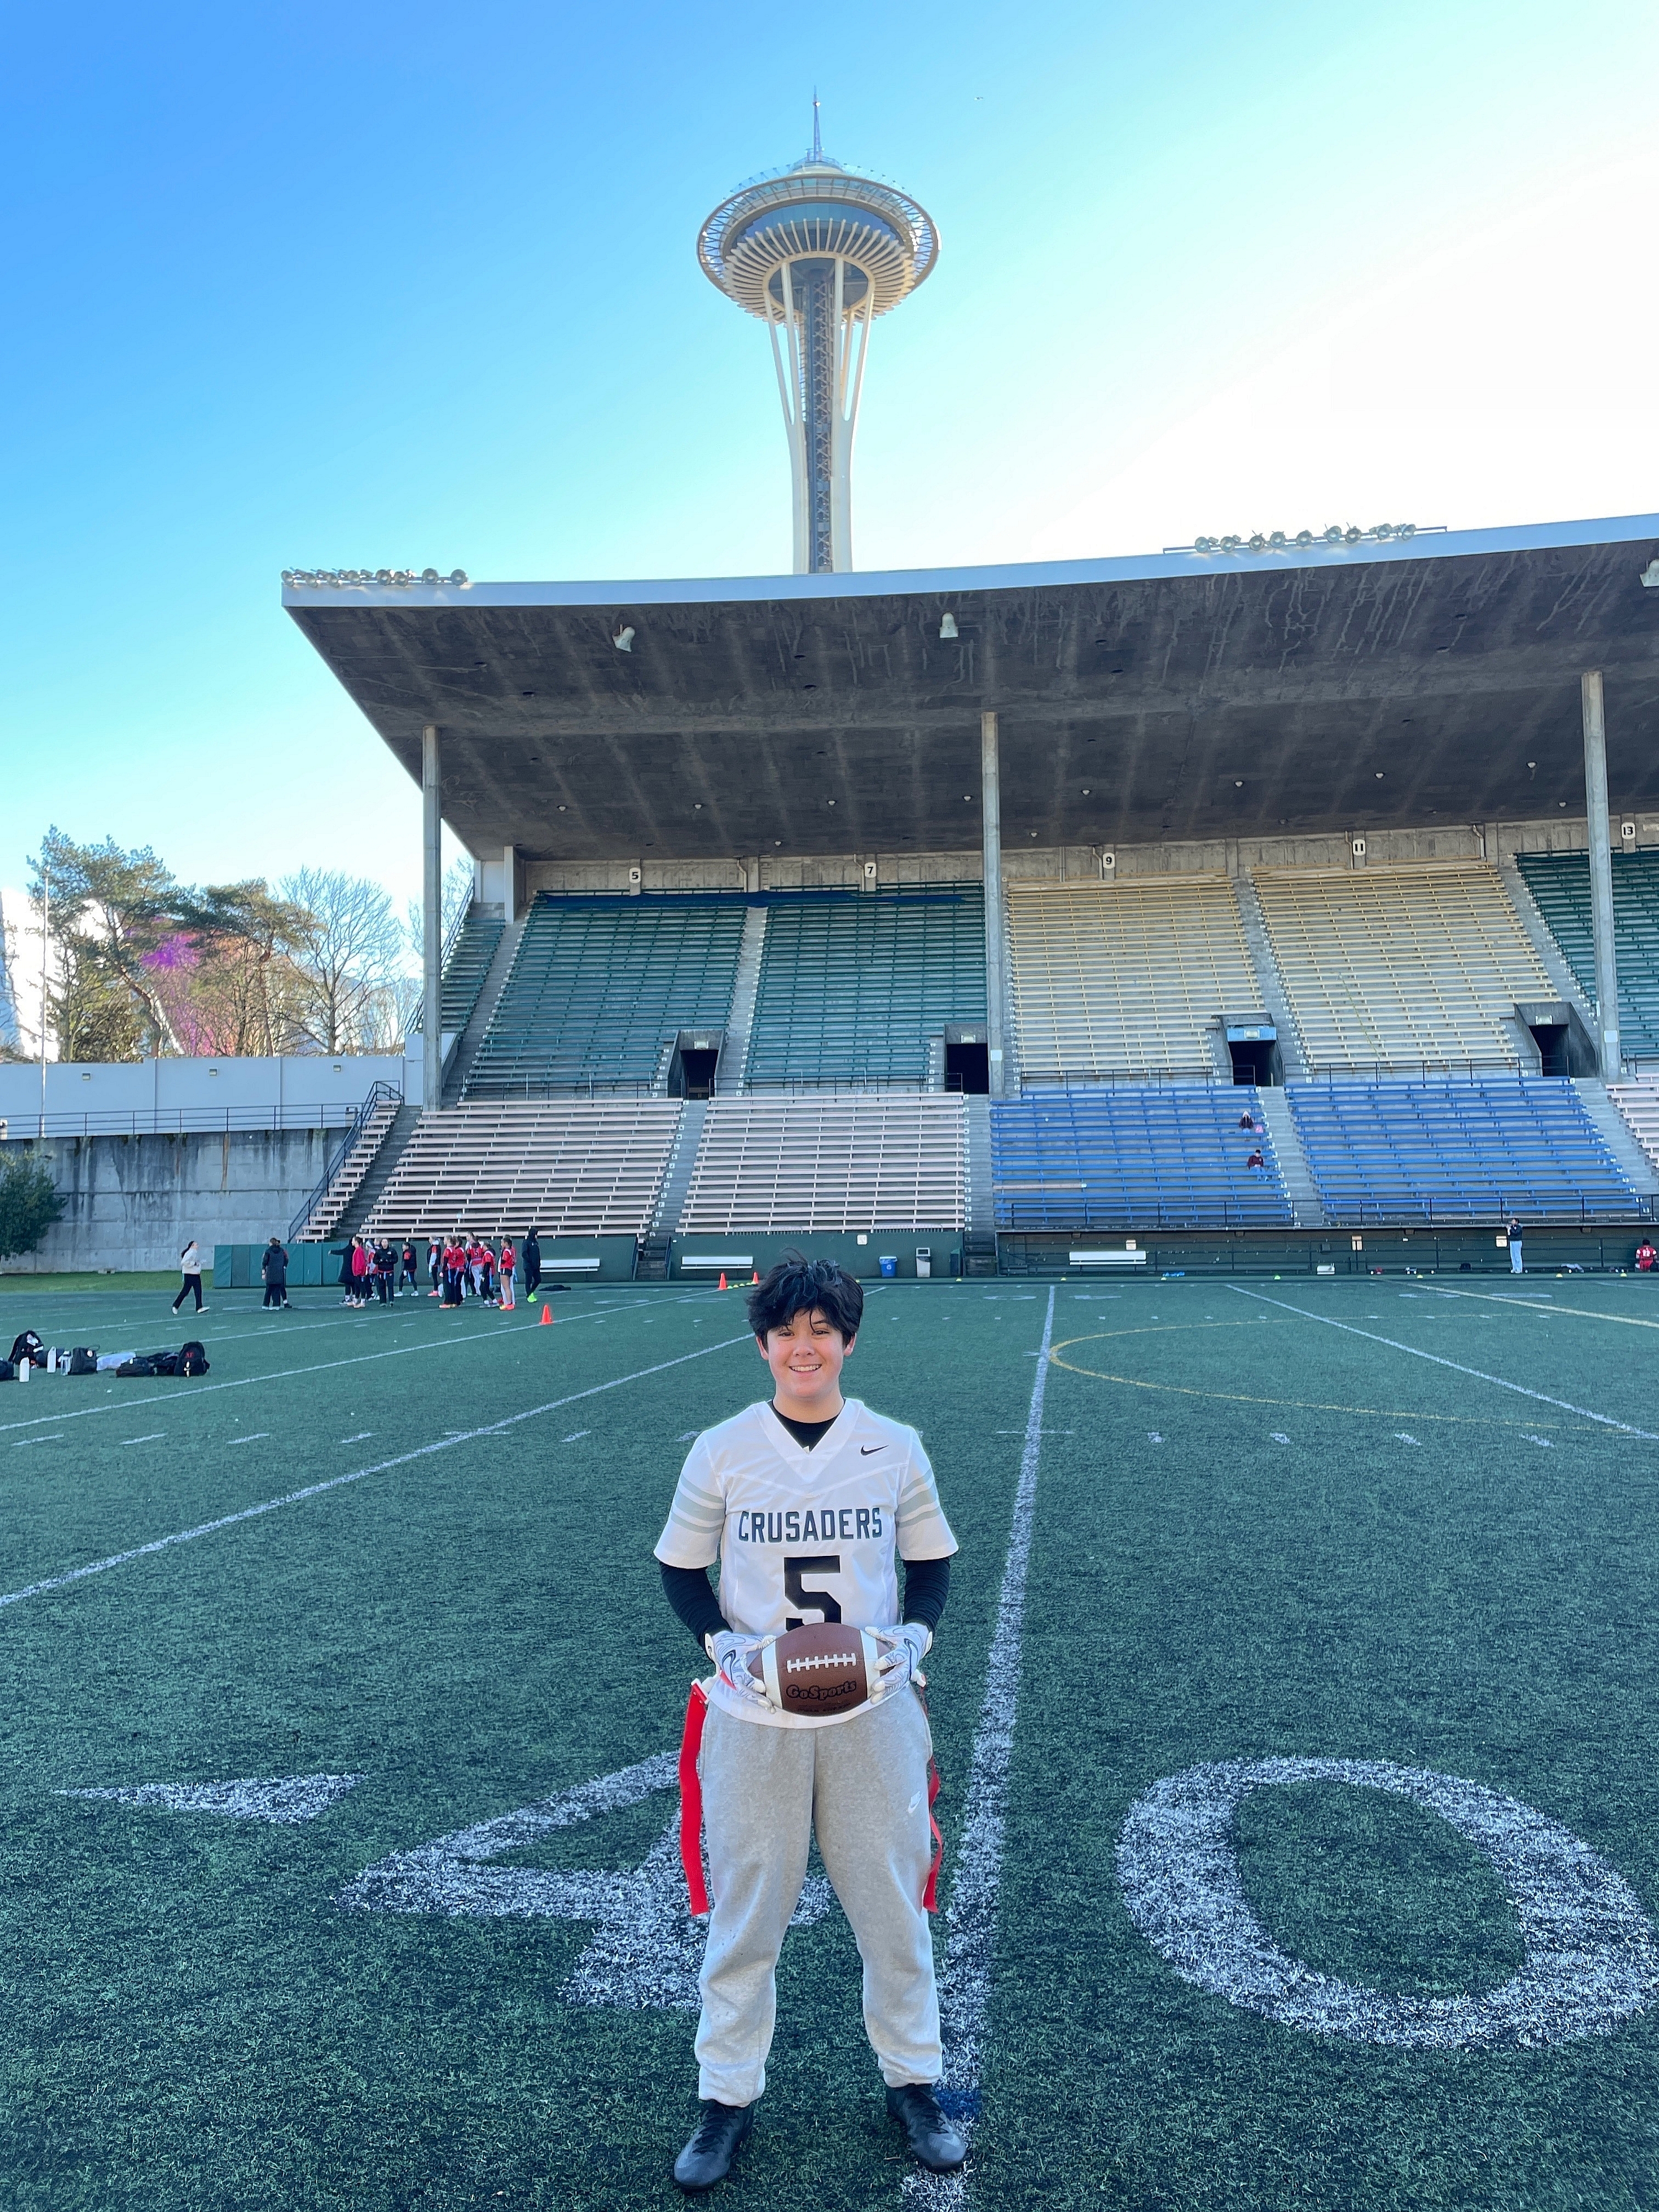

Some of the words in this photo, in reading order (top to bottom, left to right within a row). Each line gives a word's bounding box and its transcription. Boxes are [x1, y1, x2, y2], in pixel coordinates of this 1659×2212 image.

[1623, 826, 1633, 836] 13
[1355, 843, 1364, 851] 11
[1106, 856, 1112, 865] 9
[738, 1507, 882, 1543] CRUSADERS
[783, 1555, 842, 1632] 5
[786, 1680, 857, 1700] GoSports
[1114, 1754, 1659, 2051] 0
